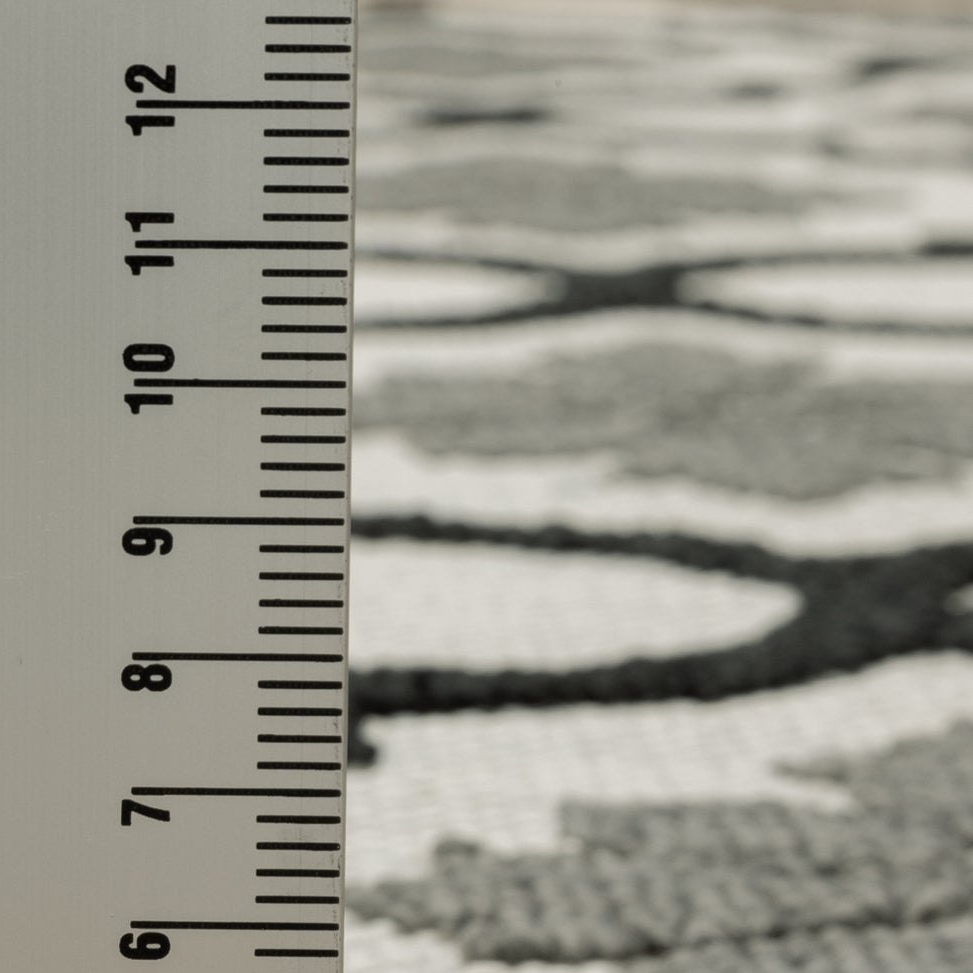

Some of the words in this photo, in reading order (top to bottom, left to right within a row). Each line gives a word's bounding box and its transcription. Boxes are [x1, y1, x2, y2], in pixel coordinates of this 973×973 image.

[124, 64, 177, 137] 12
[124, 211, 176, 276] 11
[122, 342, 176, 415] 10
[121, 526, 174, 557] 9
[120, 663, 173, 692] 8
[120, 798, 171, 827] 7
[118, 931, 171, 961] 6
